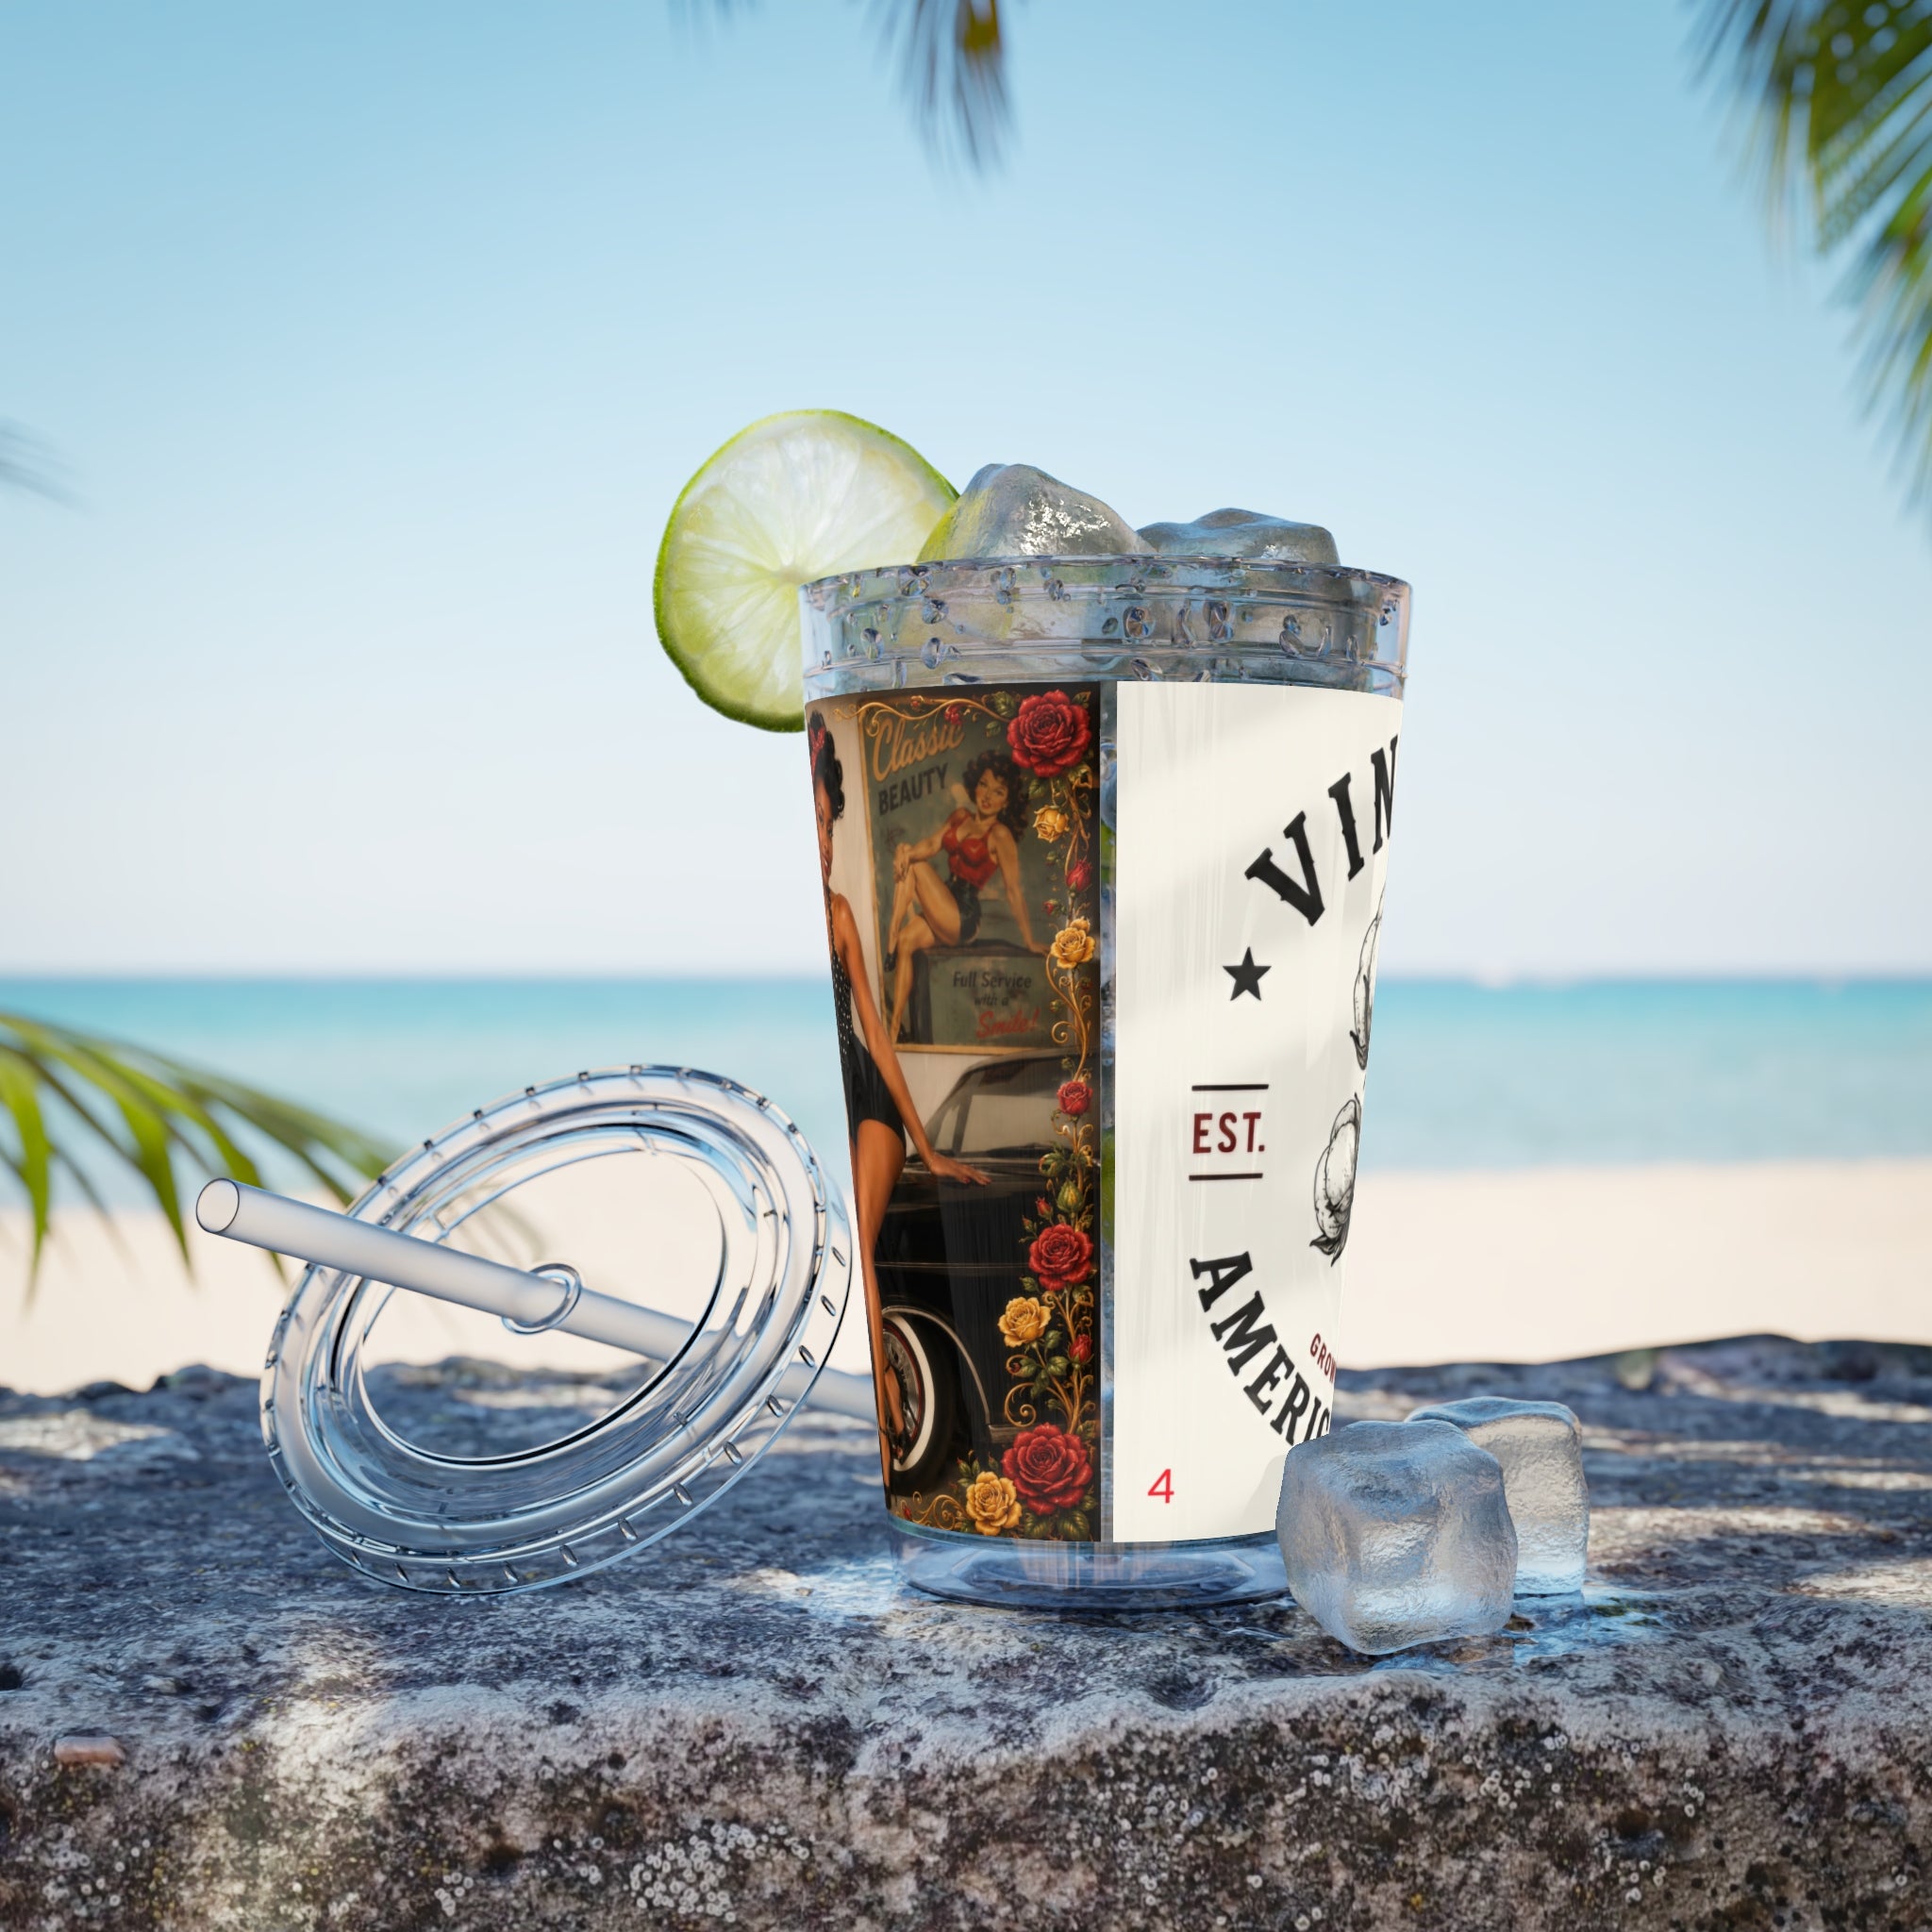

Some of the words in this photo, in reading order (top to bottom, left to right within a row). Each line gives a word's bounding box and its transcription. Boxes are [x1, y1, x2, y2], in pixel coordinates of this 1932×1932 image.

[873, 718, 965, 782] Classic
[878, 762, 948, 815] BEAUTY
[953, 970, 976, 988] Full
[981, 972, 1032, 989] Service
[976, 1007, 1041, 1039] Smile!
[1192, 1111, 1265, 1154] EST.
[1147, 1468, 1174, 1504] 4
